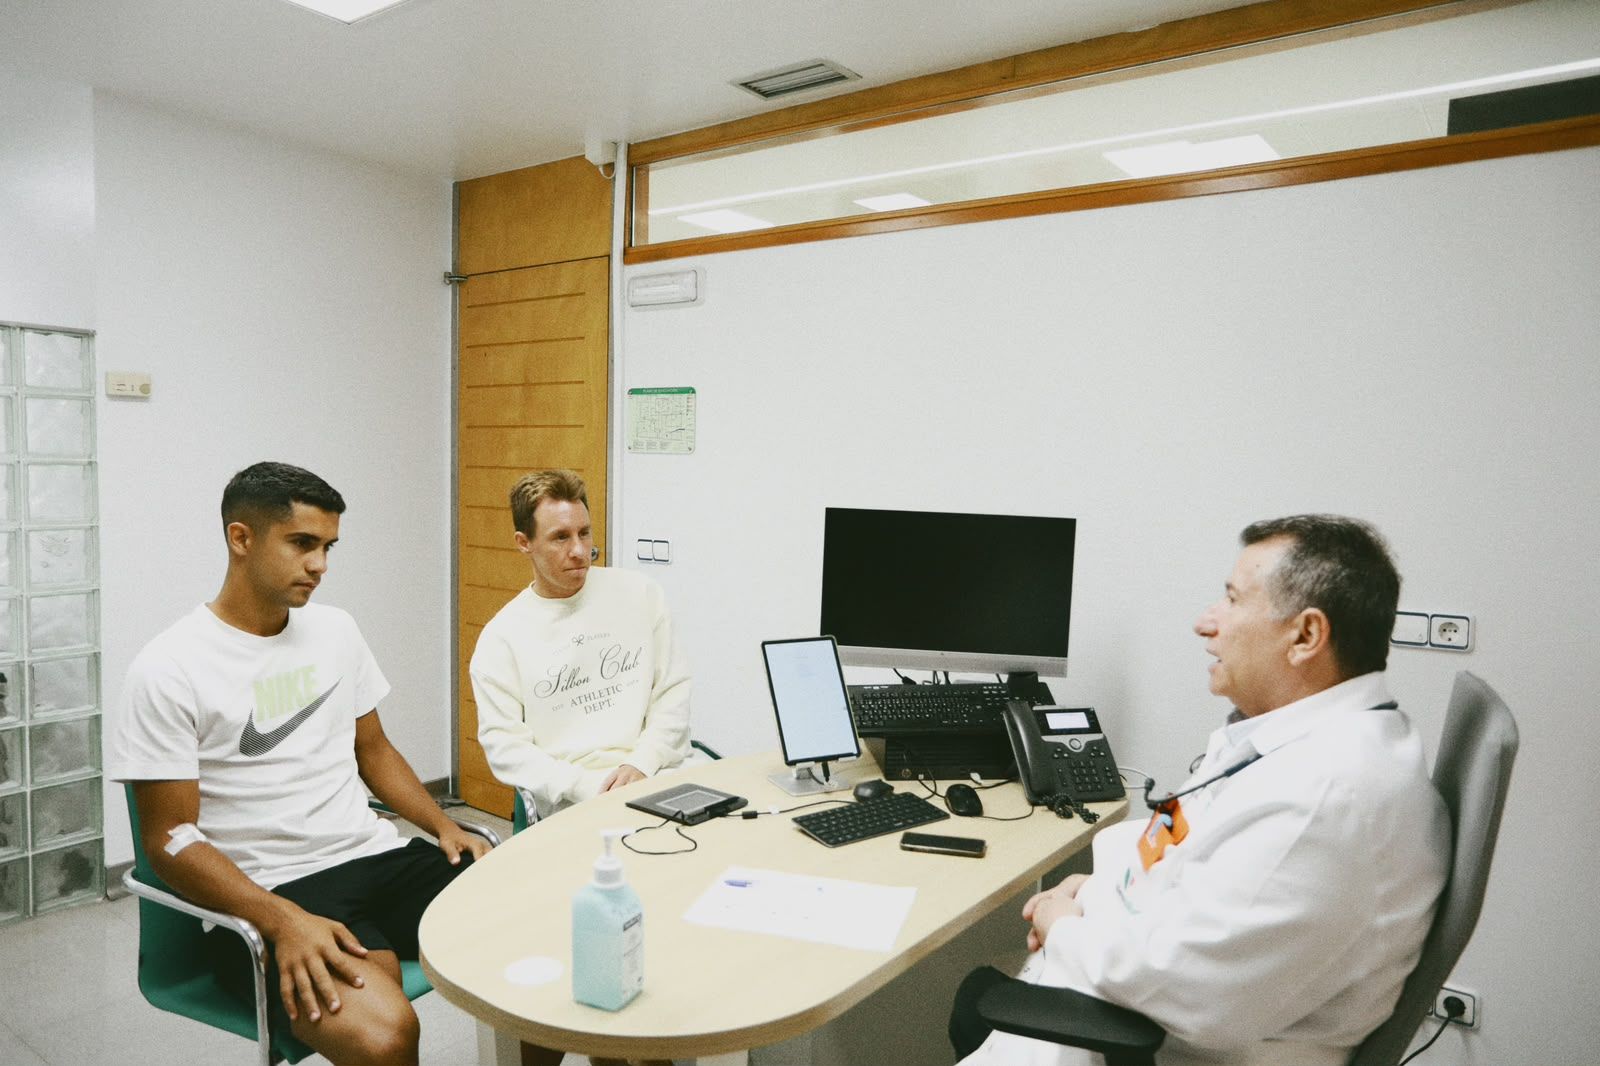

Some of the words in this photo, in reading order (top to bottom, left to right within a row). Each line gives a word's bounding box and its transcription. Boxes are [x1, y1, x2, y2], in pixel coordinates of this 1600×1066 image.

[534, 664, 590, 698] Silbon
[600, 644, 642, 680] Club
[253, 664, 319, 723] NIKE
[570, 683, 623, 707] ATHLETIC
[584, 698, 615, 714] DEPT.
